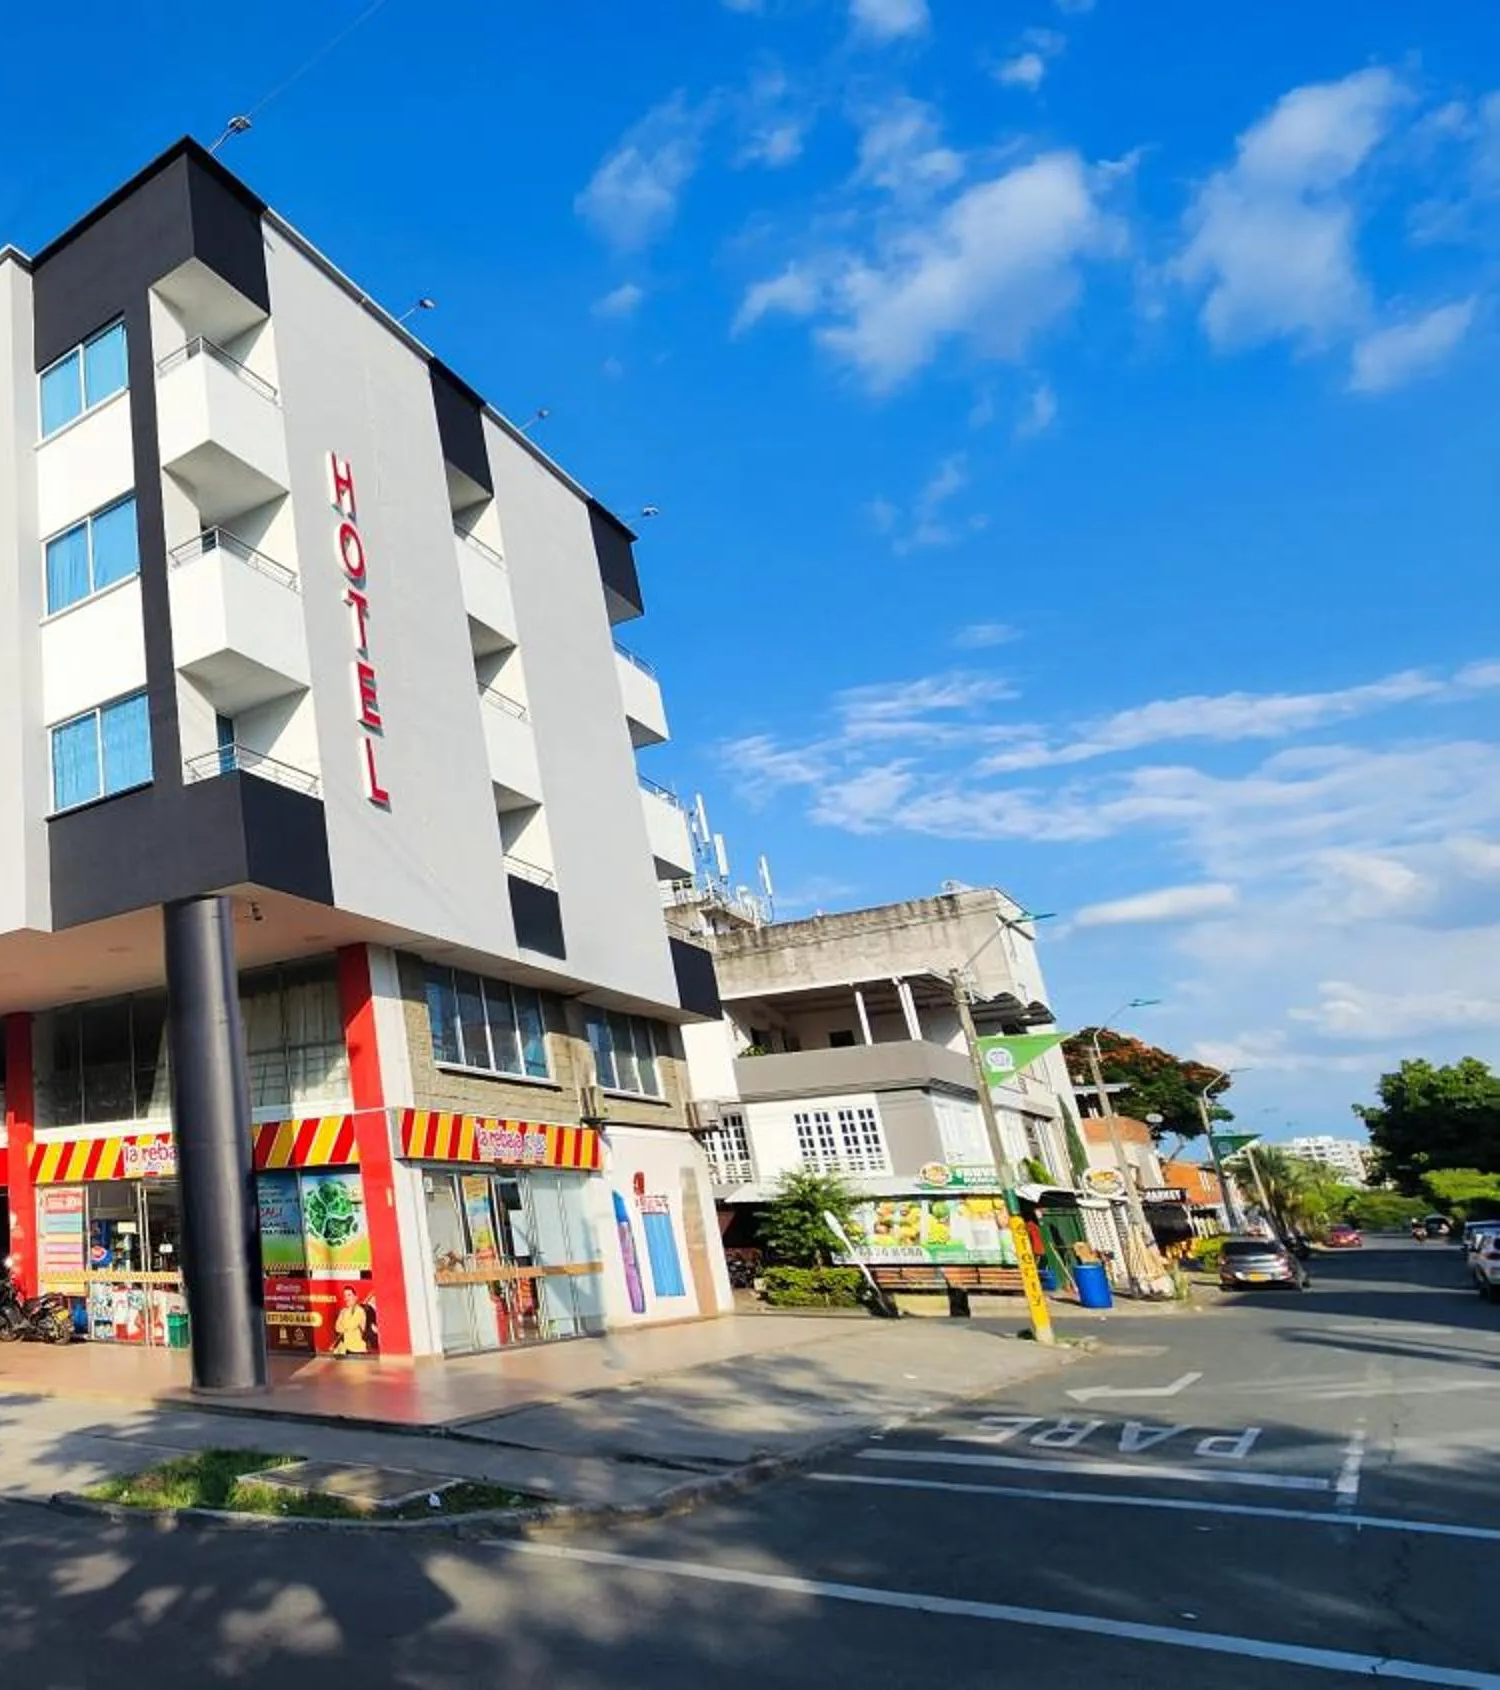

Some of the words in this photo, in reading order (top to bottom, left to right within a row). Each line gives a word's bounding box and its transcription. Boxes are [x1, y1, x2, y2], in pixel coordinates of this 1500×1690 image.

[327, 451, 390, 806] HOTEL
[125, 1144, 138, 1162] la
[141, 1142, 179, 1161] reba
[938, 1414, 1263, 1460] PARE
